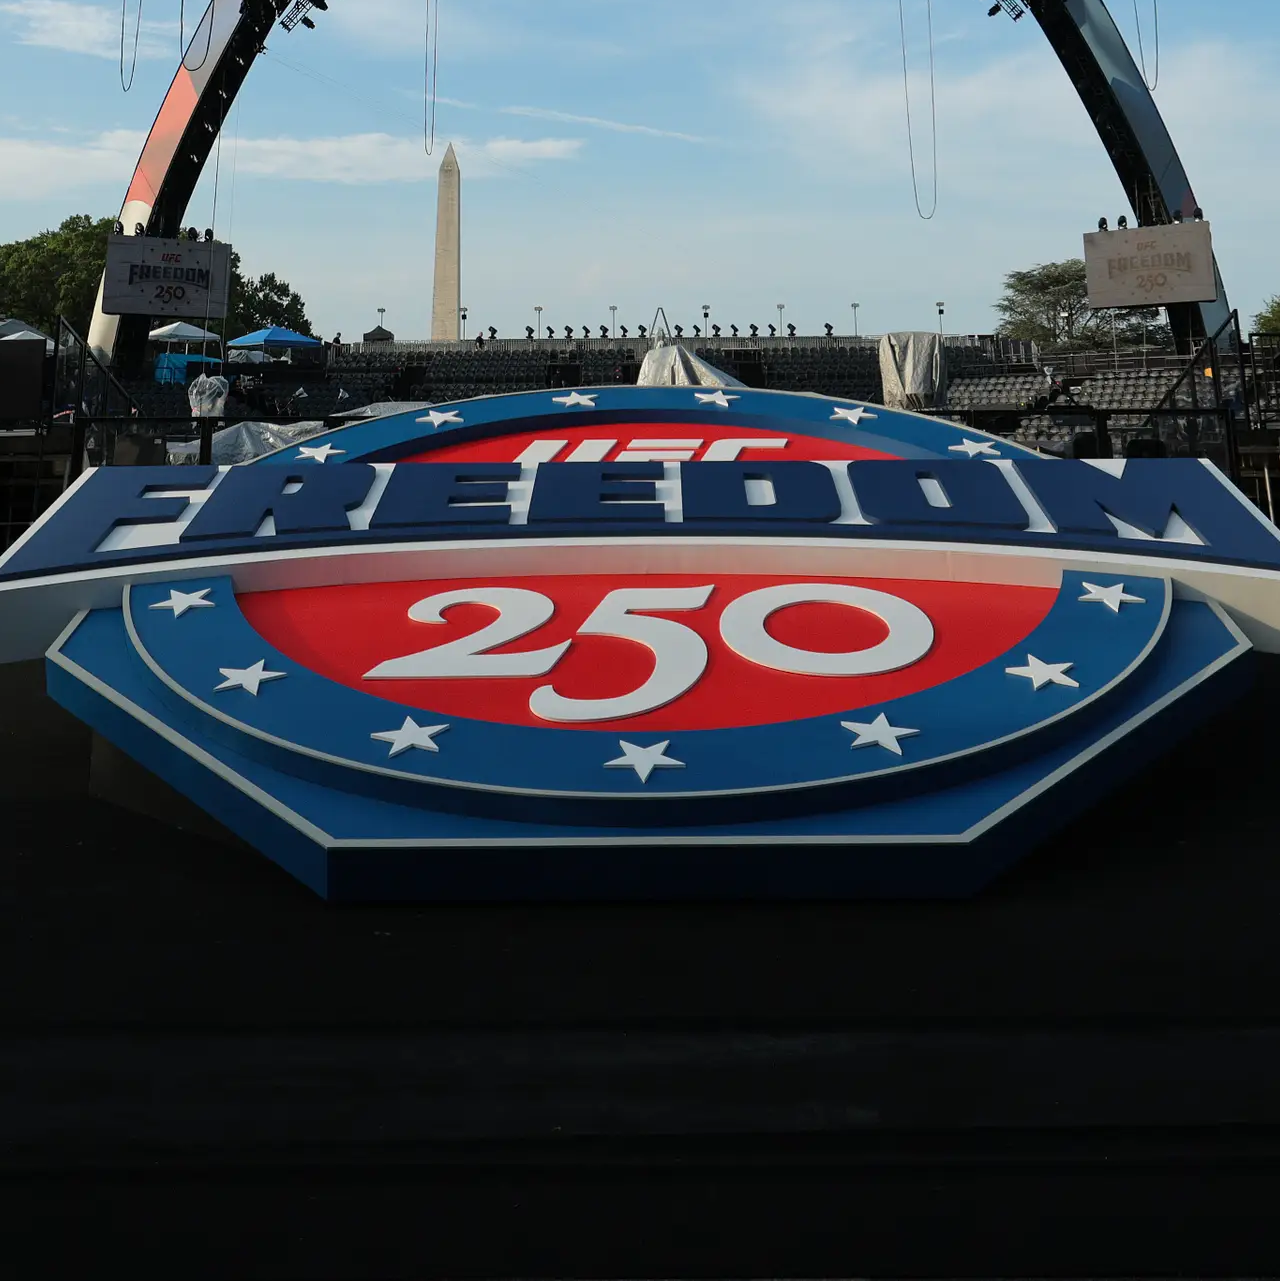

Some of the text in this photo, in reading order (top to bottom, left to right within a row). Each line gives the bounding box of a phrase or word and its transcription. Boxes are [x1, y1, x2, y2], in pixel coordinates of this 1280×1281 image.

[1136, 240, 1157, 252] UFC
[161, 253, 182, 263] UFC
[1106, 251, 1192, 279] FREEDOM
[128, 264, 209, 290] FREEDOM
[1136, 273, 1167, 293] 250
[153, 285, 185, 304] 250
[361, 583, 935, 723] 250
